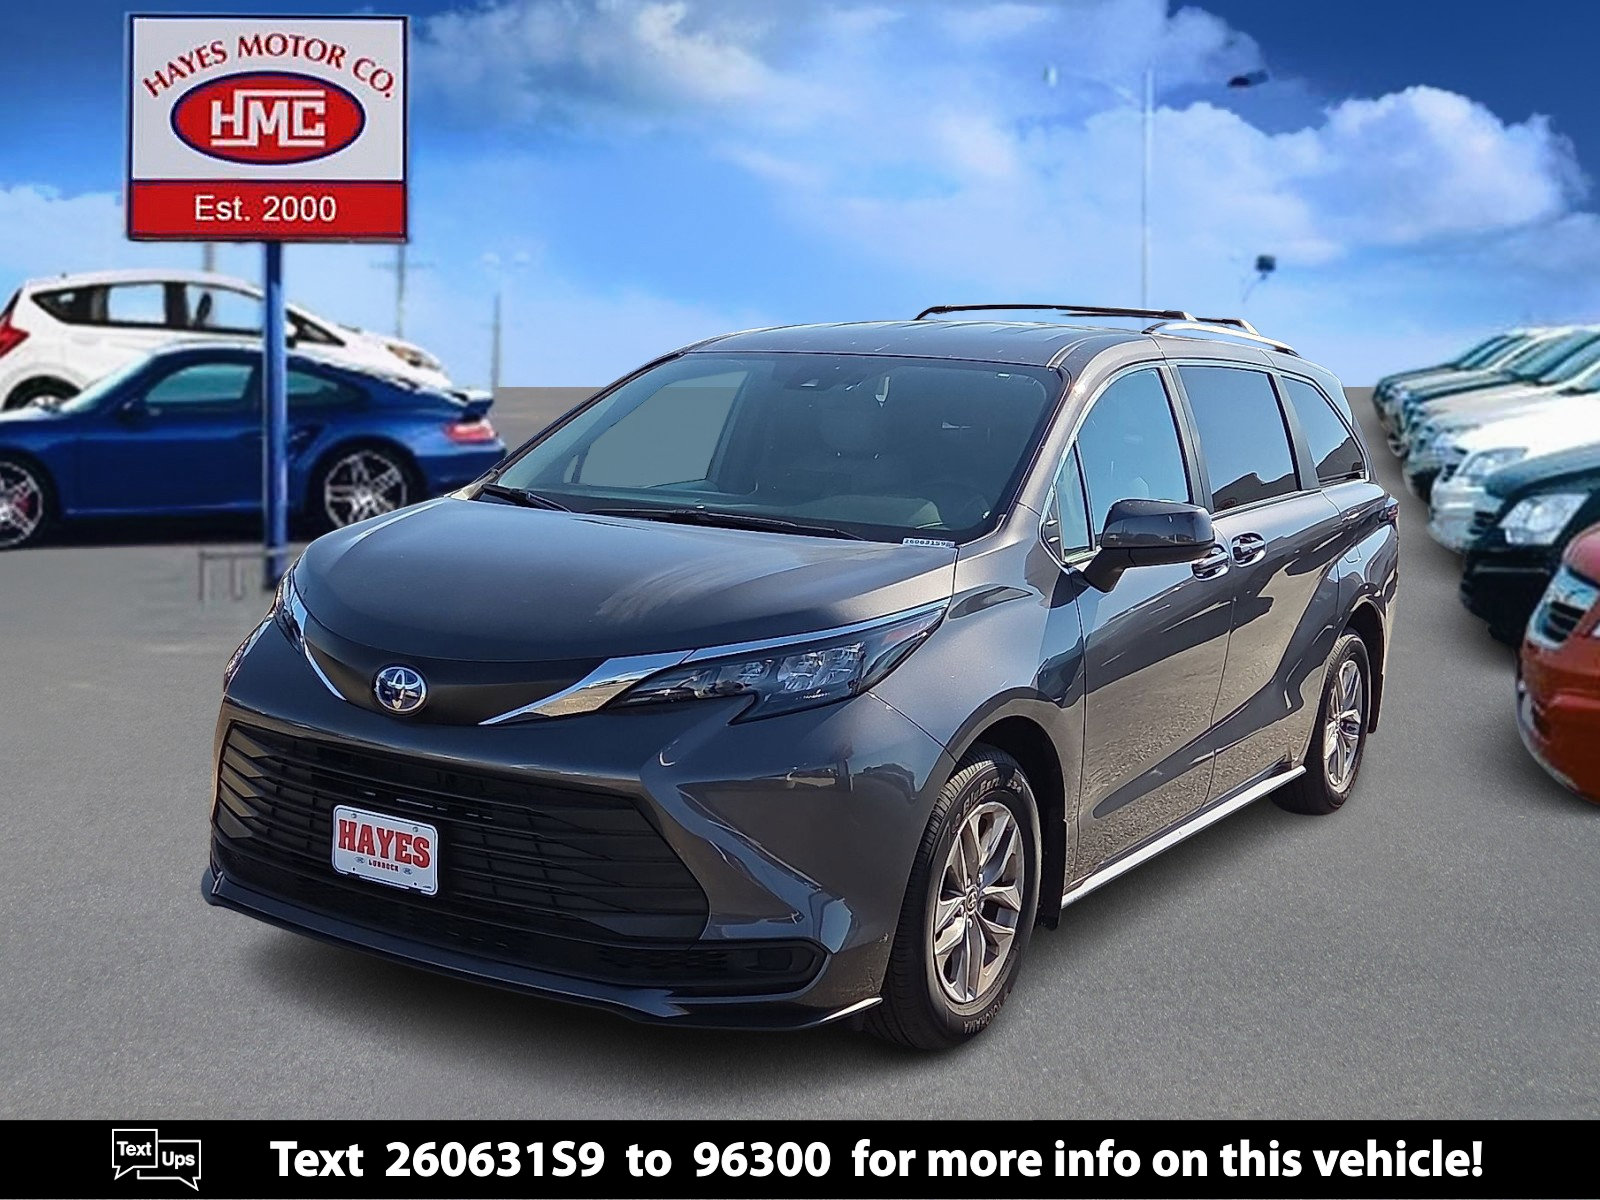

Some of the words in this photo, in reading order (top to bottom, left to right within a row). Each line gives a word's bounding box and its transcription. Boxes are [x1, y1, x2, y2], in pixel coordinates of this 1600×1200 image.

[142, 40, 228, 97] HAYES
[237, 32, 347, 69] MOTOR
[352, 57, 395, 98] CO.
[210, 89, 326, 147] HMC
[194, 194, 251, 222] Est.
[262, 195, 337, 222] 2000
[338, 819, 431, 868] HAYES
